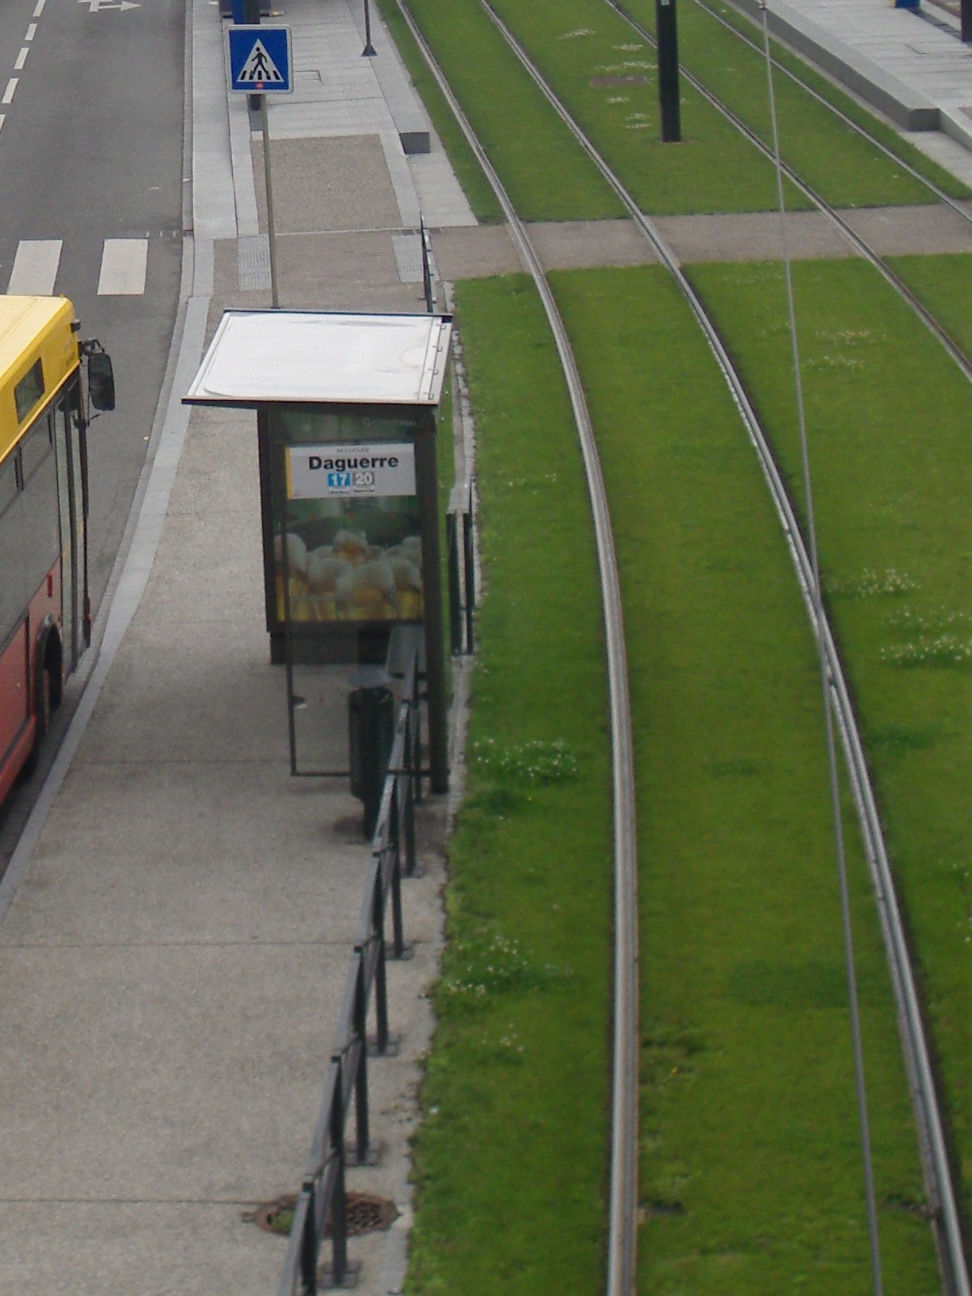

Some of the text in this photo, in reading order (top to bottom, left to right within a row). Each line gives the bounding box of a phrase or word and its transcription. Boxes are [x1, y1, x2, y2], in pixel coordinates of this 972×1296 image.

[308, 455, 399, 472] Daguerre
[331, 472, 373, 485] 17 20
